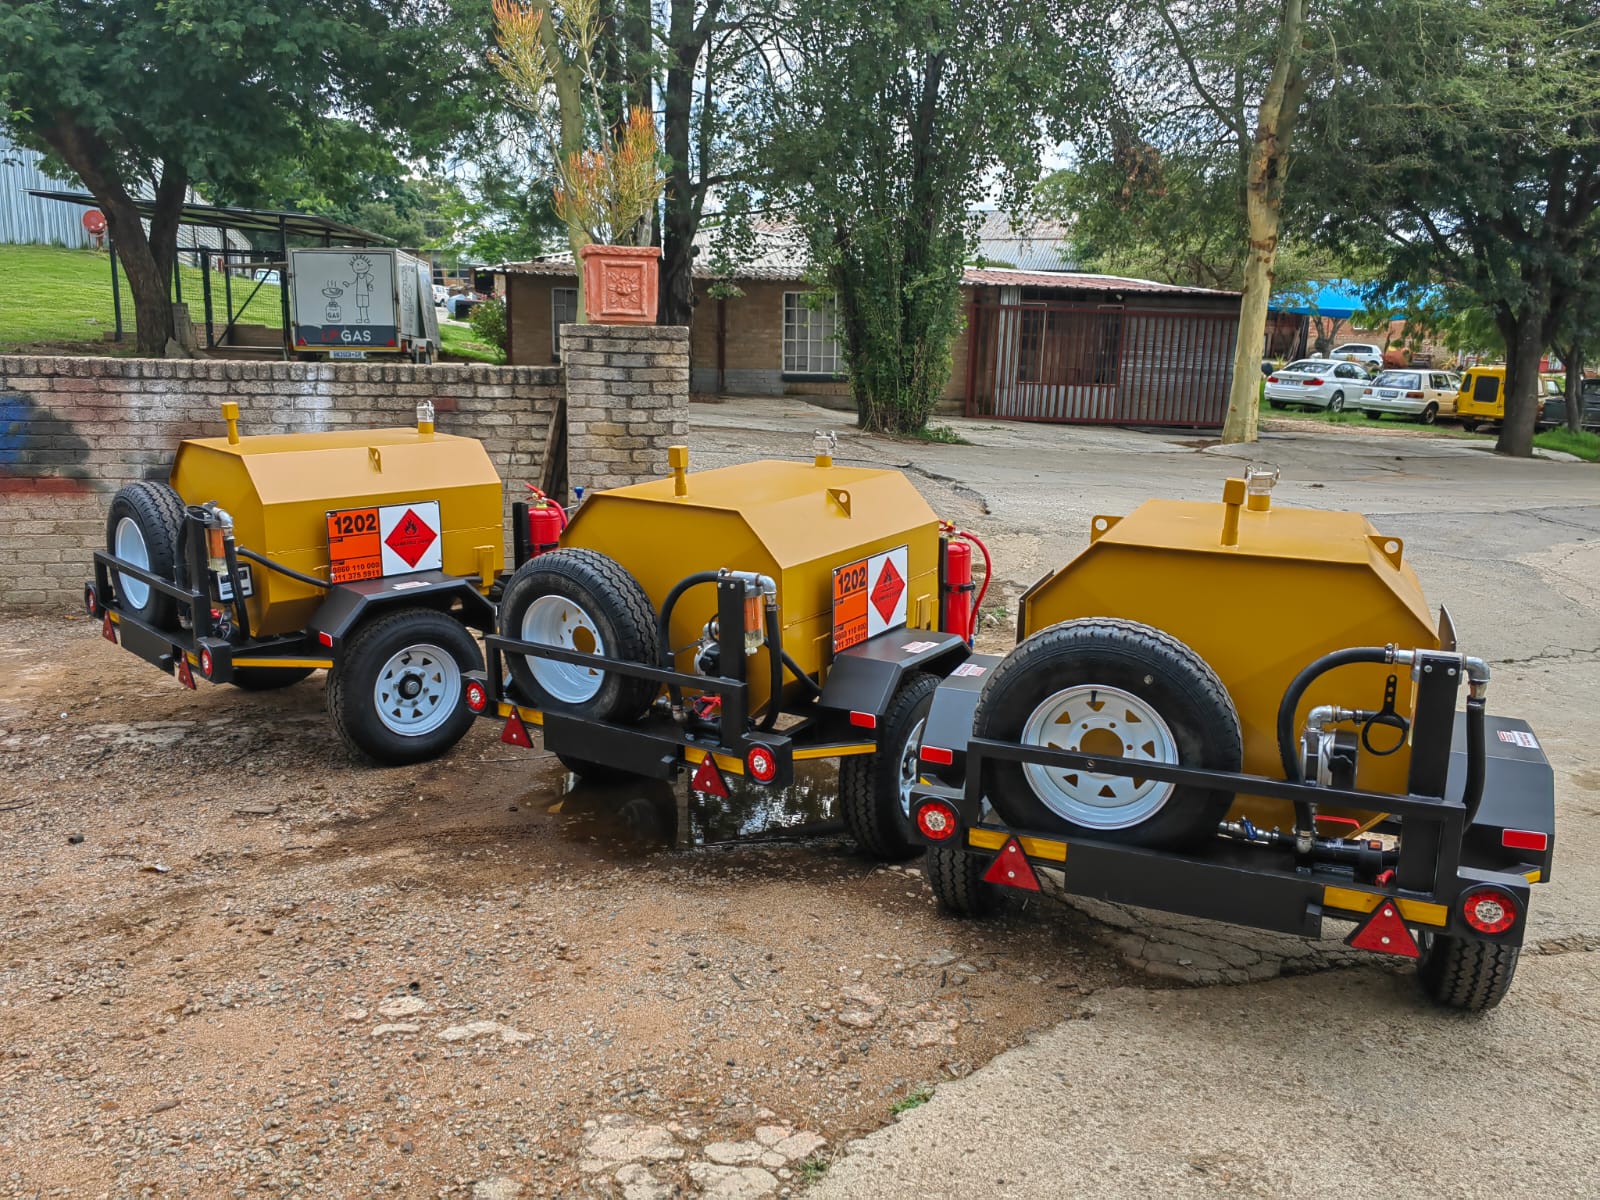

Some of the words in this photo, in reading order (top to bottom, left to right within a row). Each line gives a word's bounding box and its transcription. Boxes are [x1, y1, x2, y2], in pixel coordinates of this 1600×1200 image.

[340, 329, 372, 342] GAS
[334, 513, 377, 535] 1202
[838, 566, 866, 595] 1202
